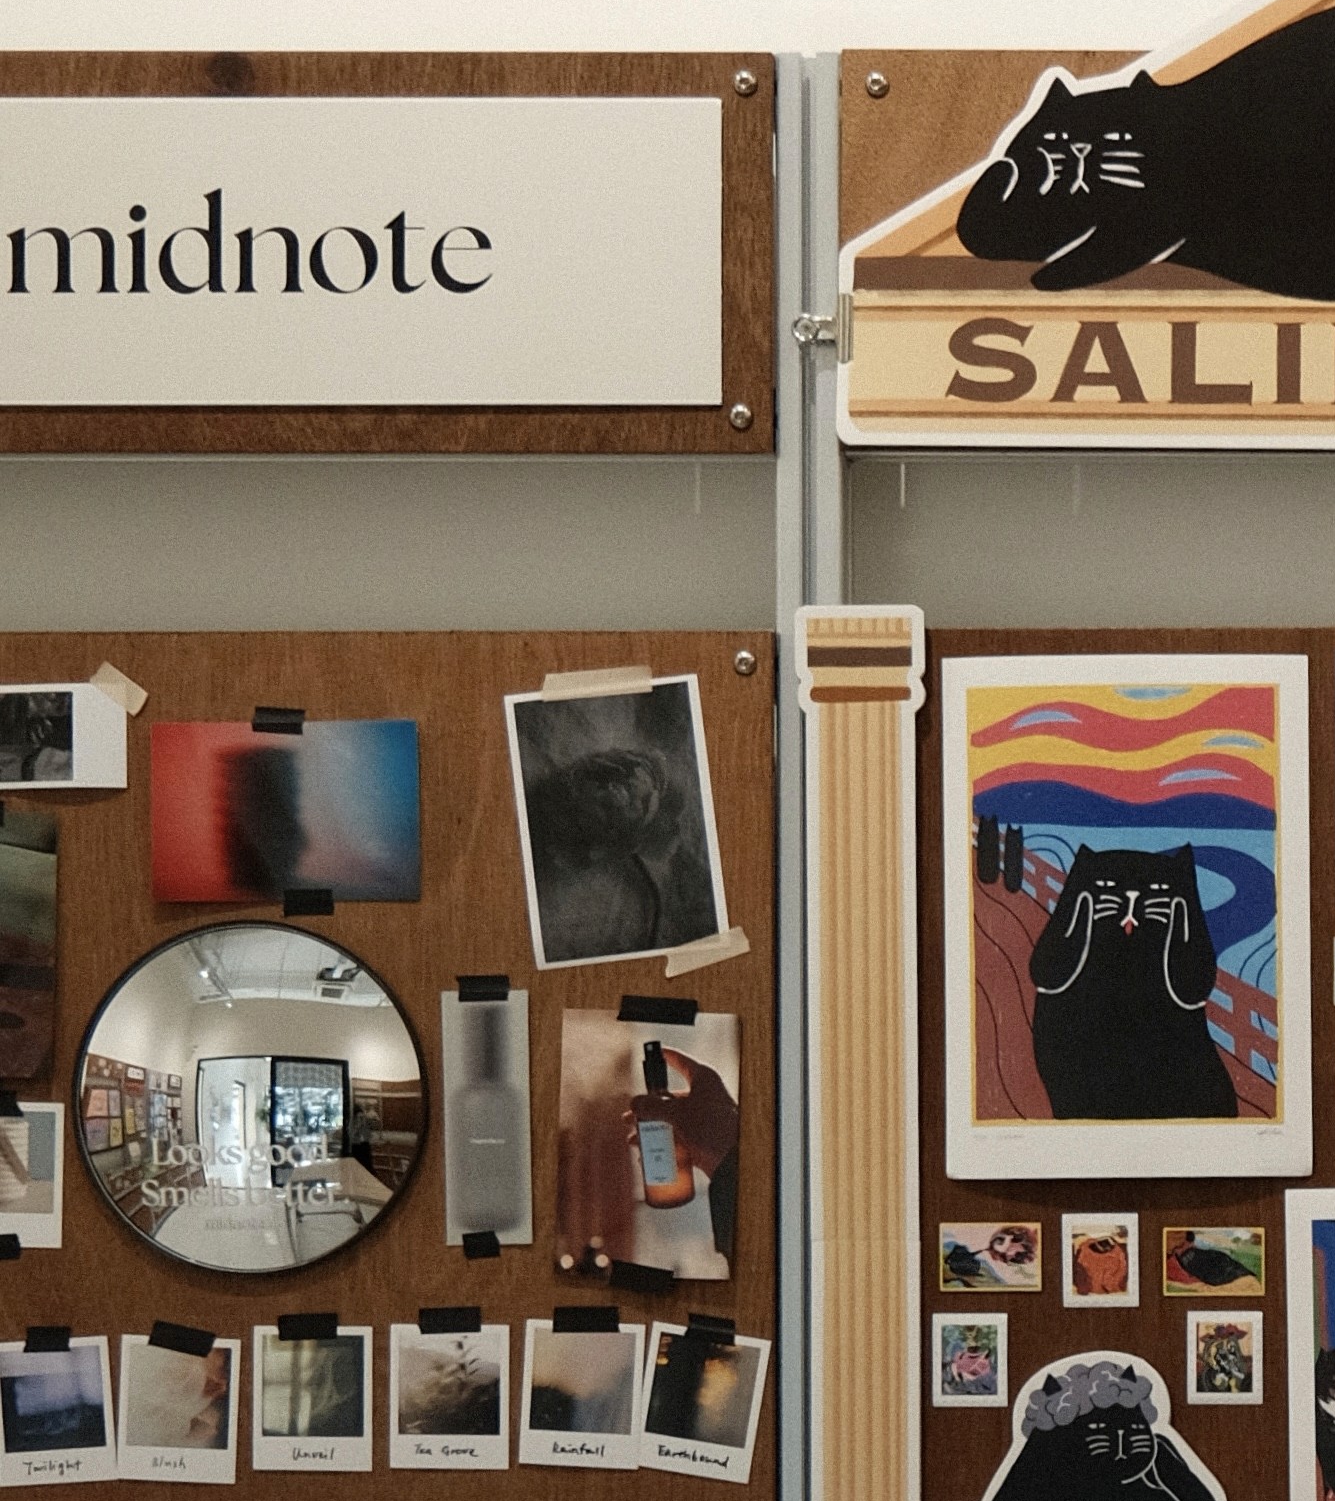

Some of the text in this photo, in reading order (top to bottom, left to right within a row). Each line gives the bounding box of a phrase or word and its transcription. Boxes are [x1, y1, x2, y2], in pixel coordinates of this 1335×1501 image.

[6, 187, 494, 295] midnote
[151, 1138, 242, 1167] Looks
[140, 1179, 238, 1208] Smells
